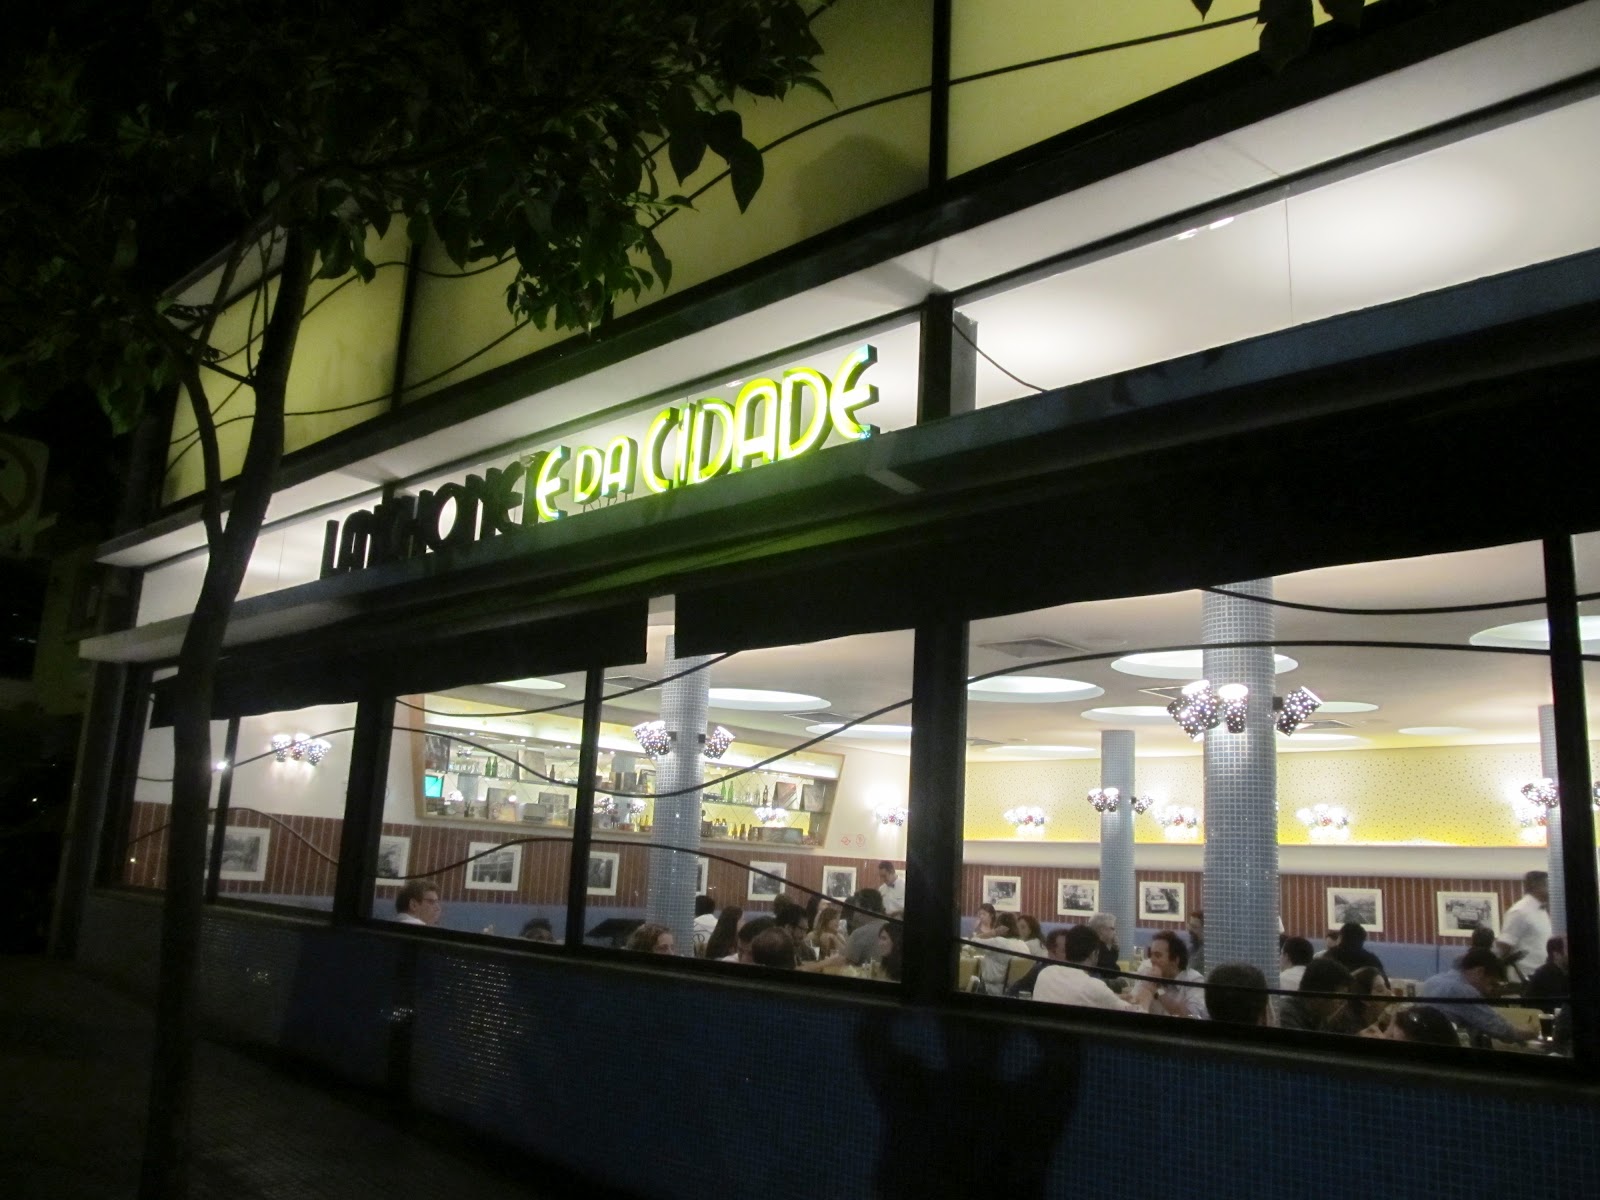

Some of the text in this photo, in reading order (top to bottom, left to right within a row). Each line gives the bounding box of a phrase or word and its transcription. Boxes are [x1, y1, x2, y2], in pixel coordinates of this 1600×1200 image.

[321, 344, 880, 577] LAHONETE DA CIDADE
